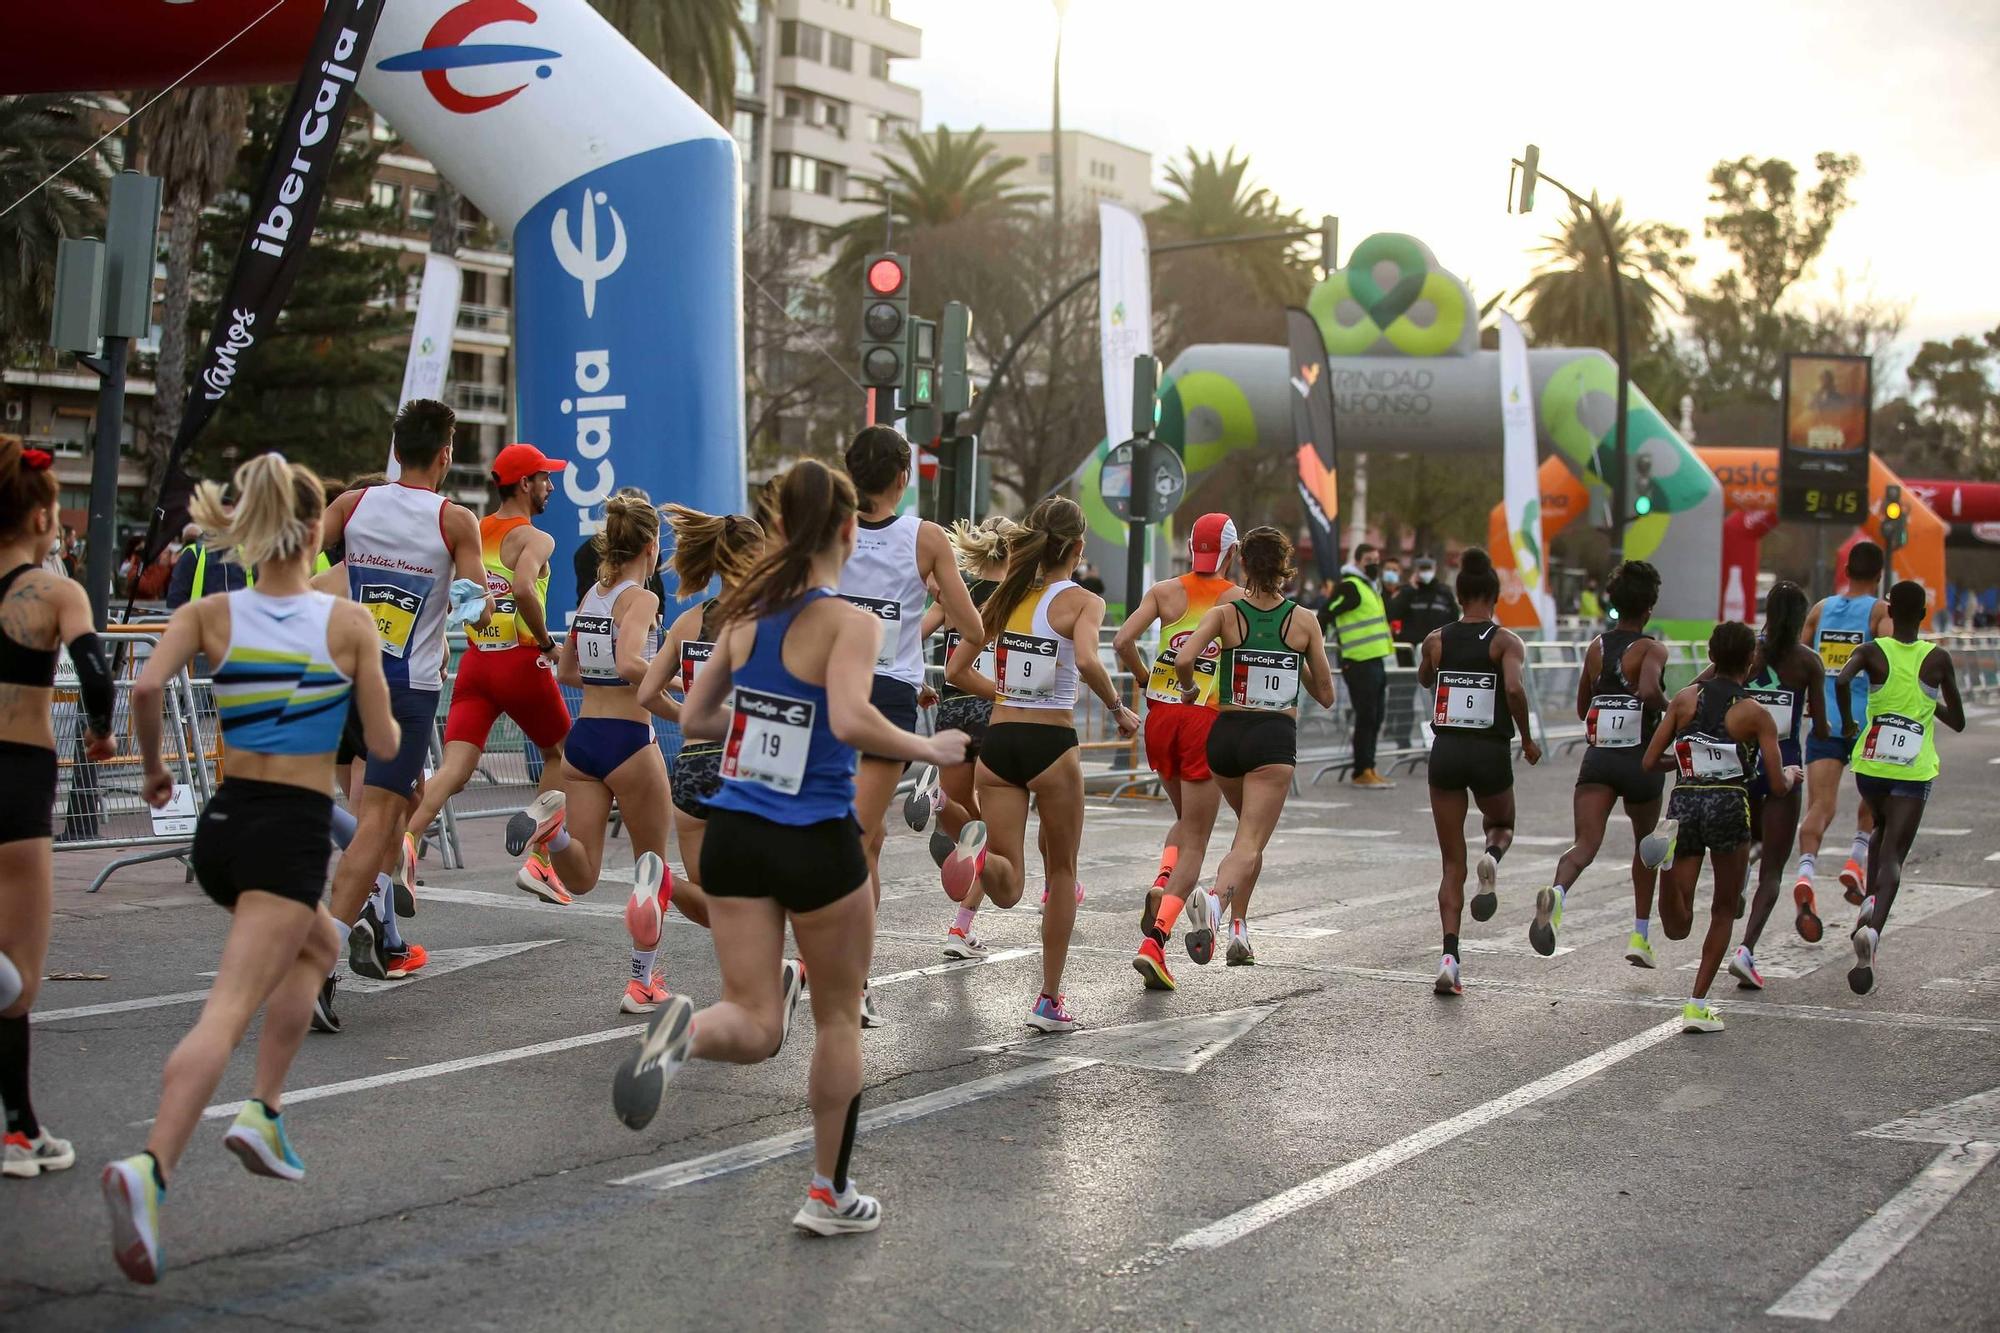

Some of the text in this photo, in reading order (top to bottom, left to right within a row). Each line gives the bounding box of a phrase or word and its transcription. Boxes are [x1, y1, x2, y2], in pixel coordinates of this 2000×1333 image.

[251, 27, 358, 258] iberCaja
[348, 553, 365, 564] Club
[397, 560, 433, 574] Manresa
[368, 590, 395, 601] iberCaja
[575, 620, 597, 631] iberCaja
[587, 641, 598, 657] 13
[1003, 637, 1033, 650] iberCaja
[1241, 654, 1275, 665] iberCaja
[1024, 661, 1032, 678] 9
[1264, 675, 1280, 690] 10
[1443, 676, 1474, 686] iberCaja
[1466, 695, 1474, 709] 6
[1594, 699, 1621, 708] iberCaja
[1611, 716, 1624, 730] 17
[1877, 717, 1905, 727] iberCaja
[762, 732, 781, 758] 19
[1892, 733, 1906, 747] 18
[1706, 748, 1721, 760] 16
